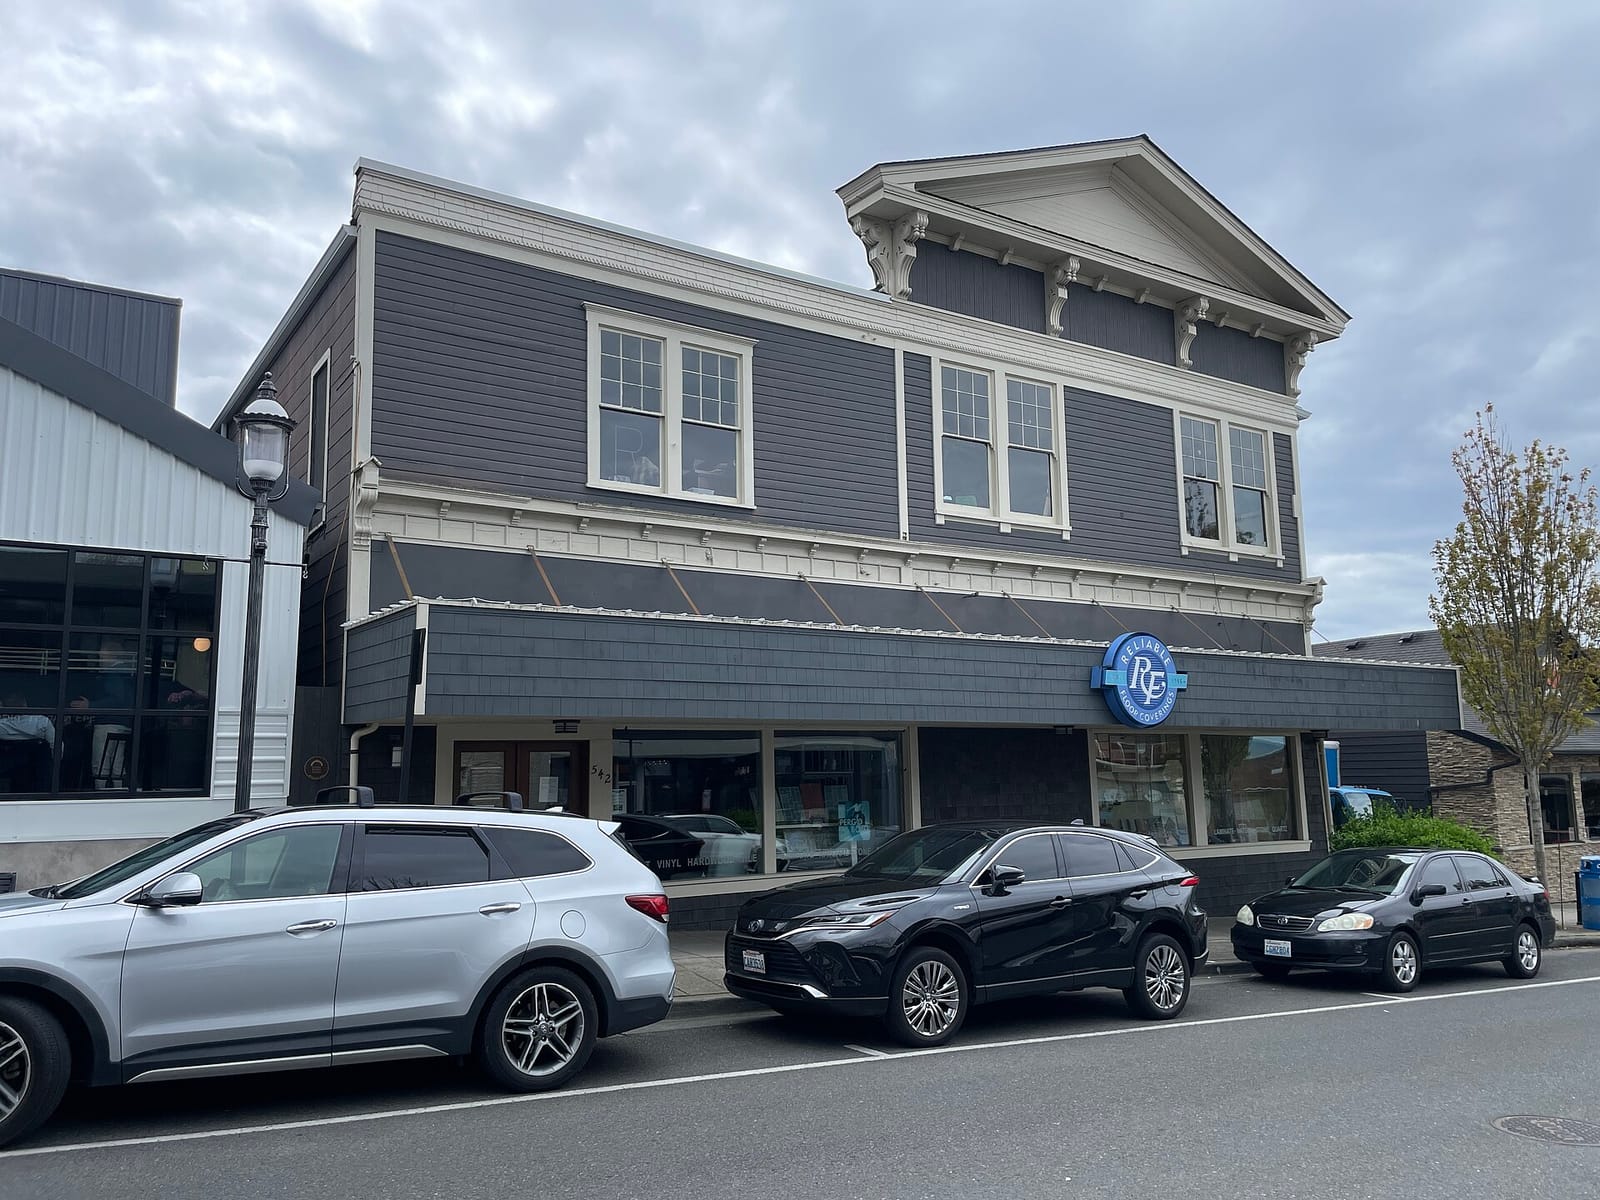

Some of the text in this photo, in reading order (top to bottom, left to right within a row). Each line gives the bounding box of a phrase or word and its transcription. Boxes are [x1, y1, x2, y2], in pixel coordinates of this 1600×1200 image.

[1120, 638, 1173, 666] RELIABLE
[1120, 690, 1175, 722] FLOOR COVERINGS
[591, 765, 611, 784] 542
[656, 858, 682, 869] VINYL
[687, 856, 735, 867] HARDWOOD
